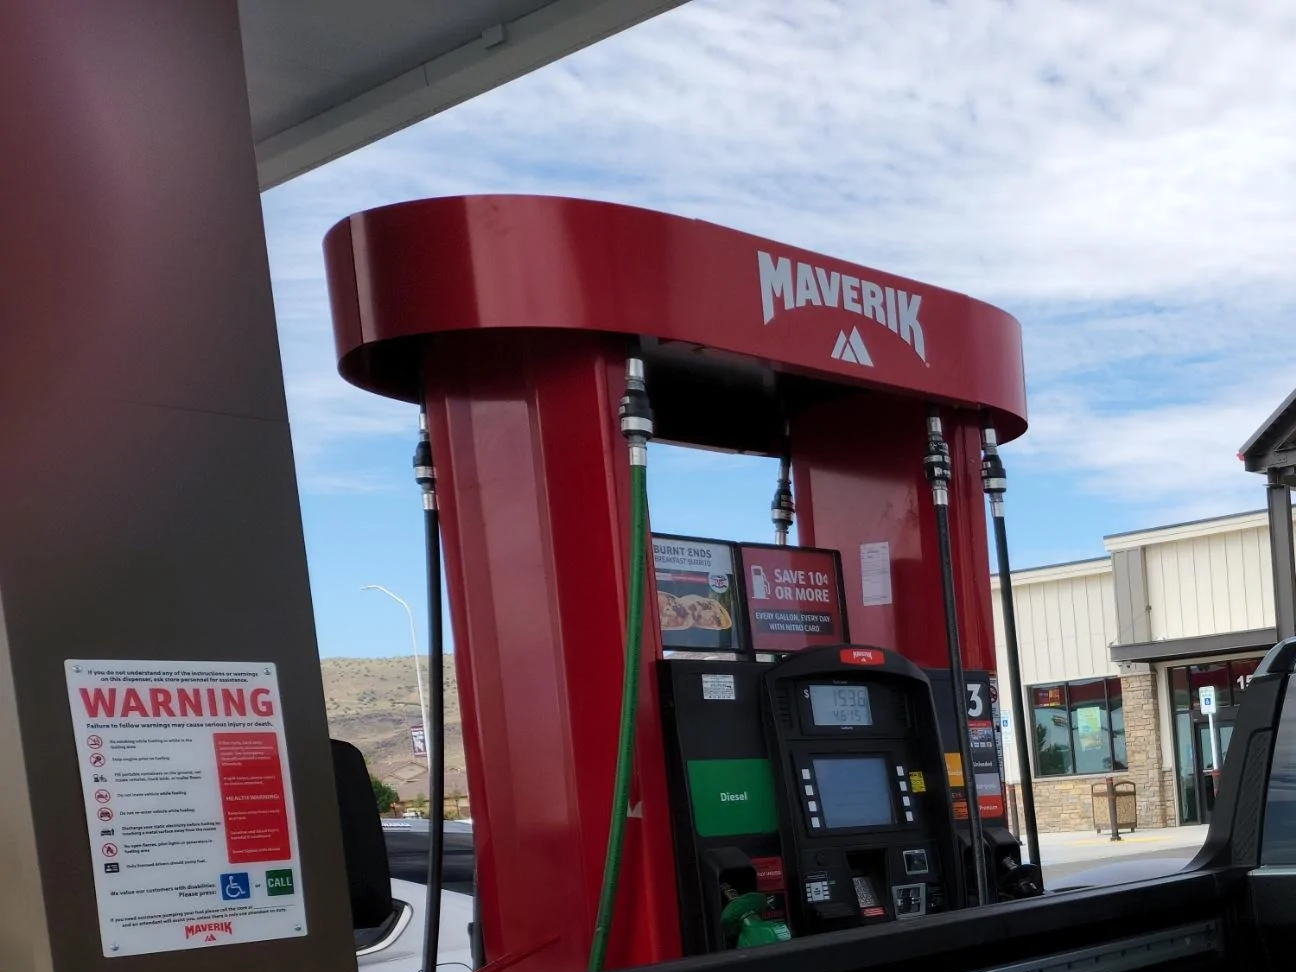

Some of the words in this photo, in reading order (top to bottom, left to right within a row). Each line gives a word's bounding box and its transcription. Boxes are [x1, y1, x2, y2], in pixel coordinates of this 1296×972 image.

[757, 250, 926, 364] MAVERIK
[654, 544, 685, 556] BURNT
[688, 548, 712, 558] ENDS
[774, 569, 806, 585] SAVE
[808, 572, 828, 586] 10¢
[776, 588, 794, 600] OR
[796, 588, 830, 602] MORE
[755, 612, 774, 620] EVERY
[800, 614, 818, 622] EVERY
[78, 687, 274, 718] WARNING
[966, 684, 983, 718] 3
[720, 791, 748, 802] Diesel
[267, 876, 293, 888] CALL
[184, 922, 233, 940] MAVERIK
